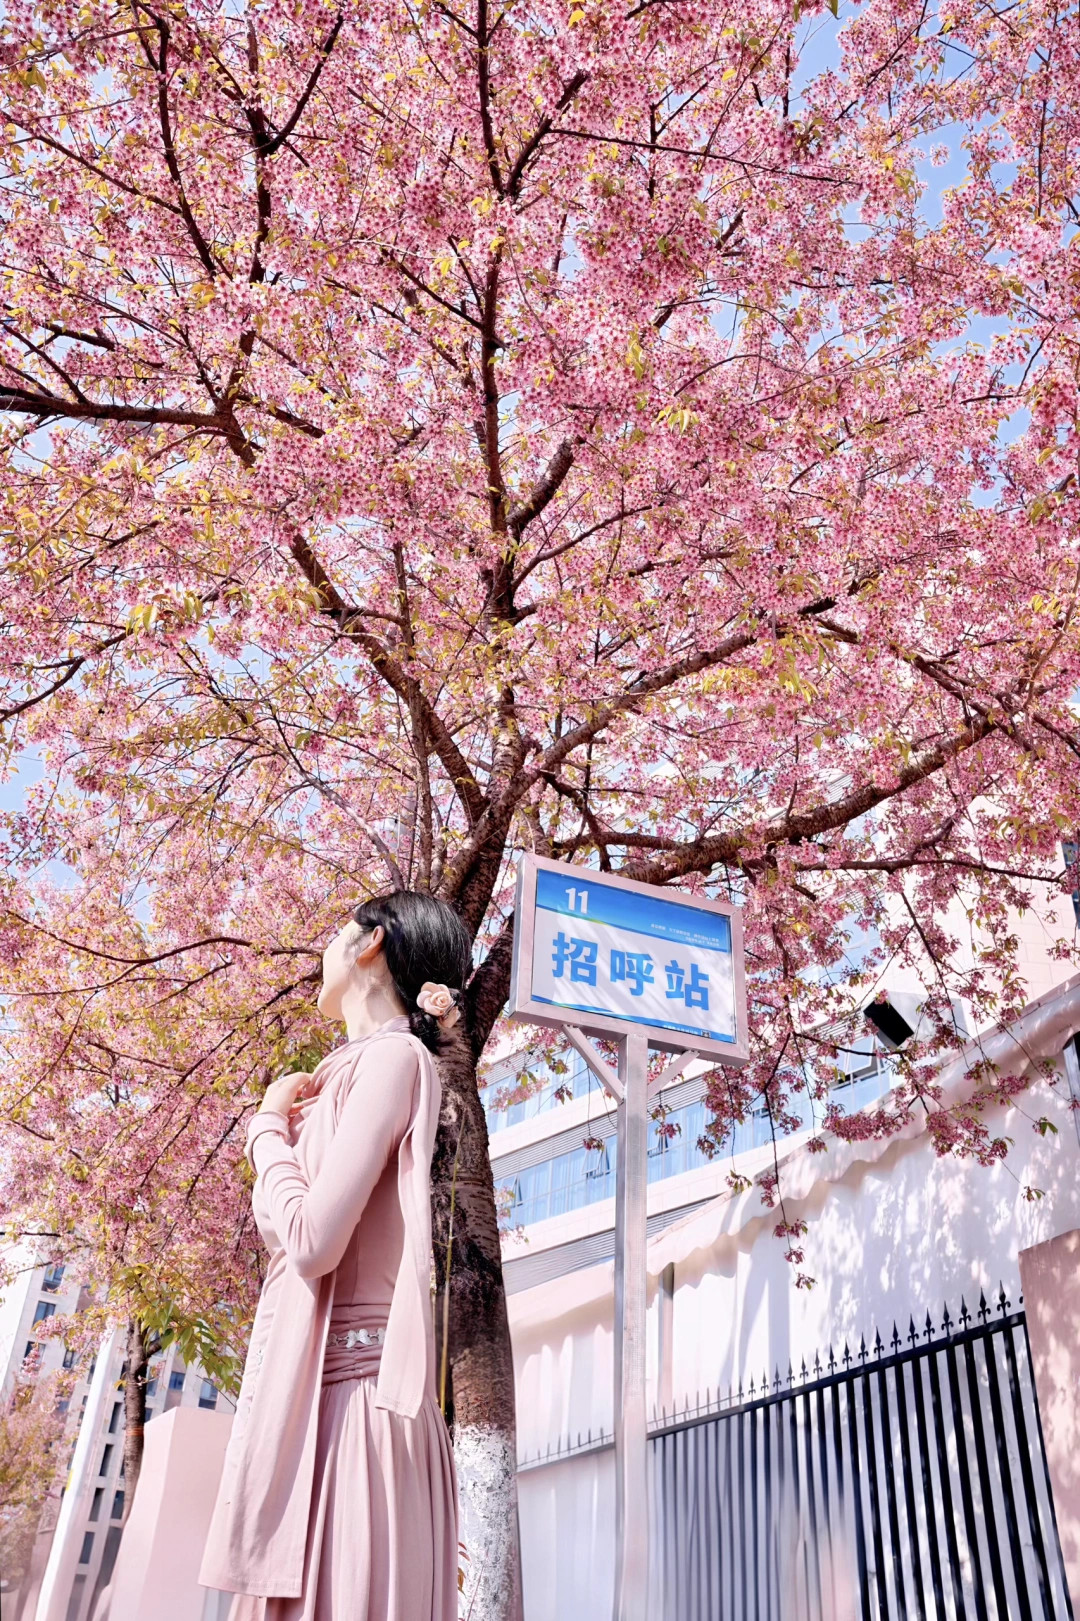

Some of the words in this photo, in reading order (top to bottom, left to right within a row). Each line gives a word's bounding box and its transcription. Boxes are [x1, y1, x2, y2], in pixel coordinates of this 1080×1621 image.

[565, 887, 589, 914] 11
[551, 931, 710, 1011] 招呼站
